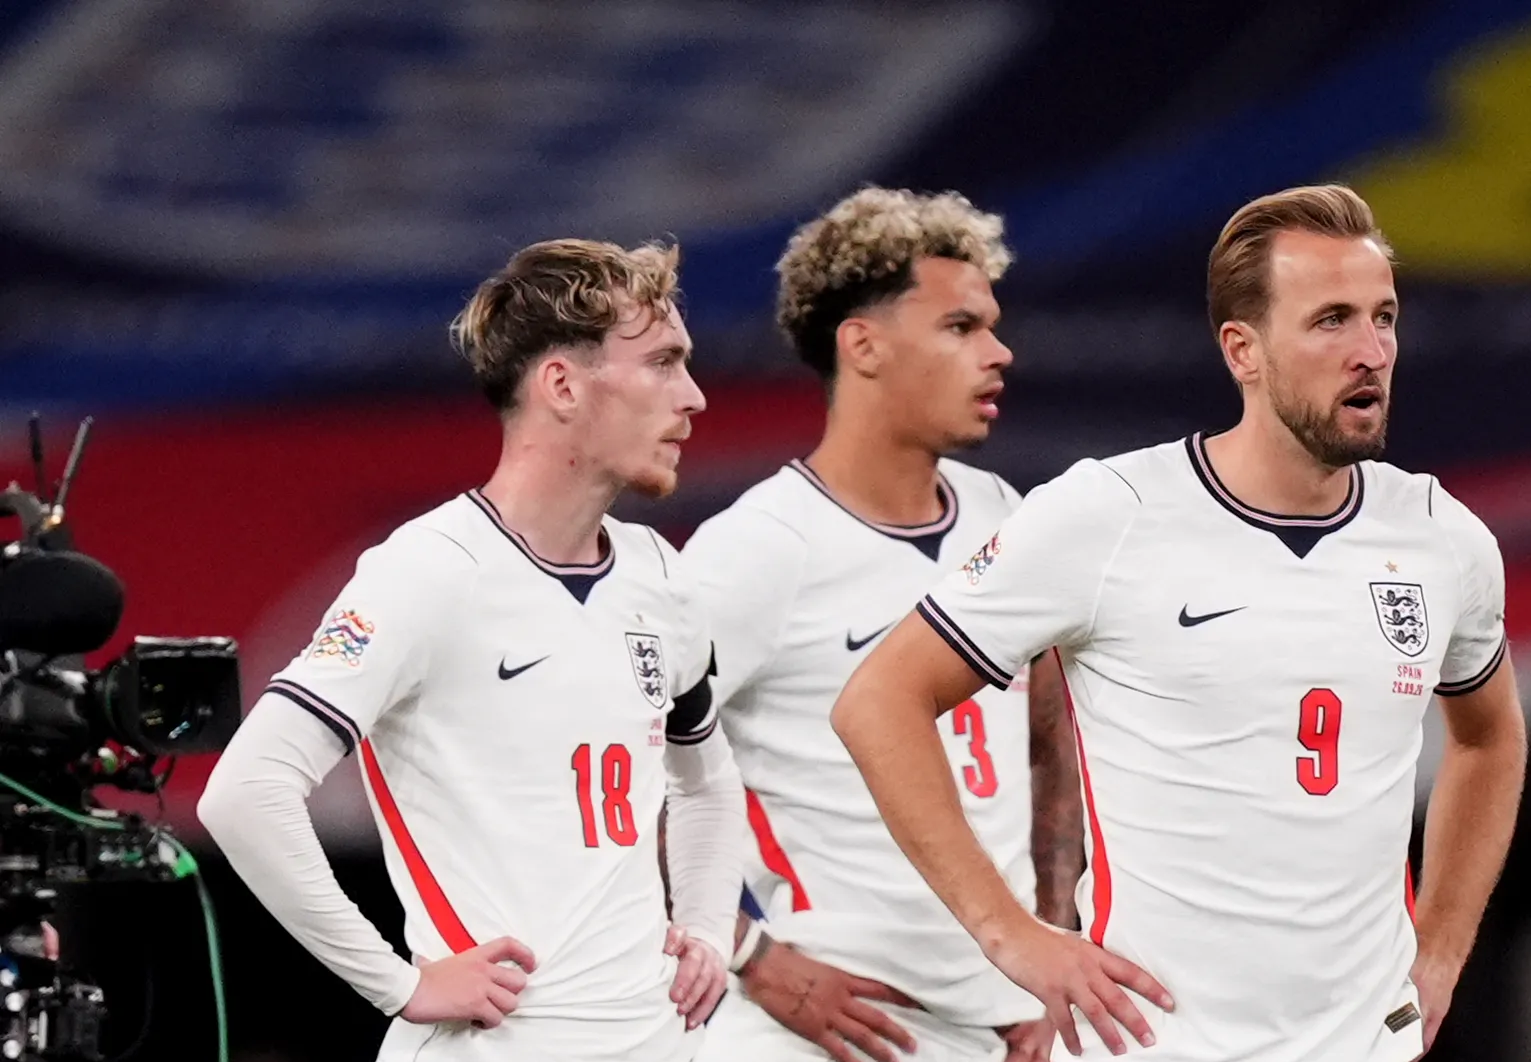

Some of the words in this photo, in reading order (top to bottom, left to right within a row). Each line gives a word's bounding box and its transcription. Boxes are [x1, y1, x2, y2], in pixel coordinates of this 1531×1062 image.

[1396, 664, 1423, 680] SPAIN
[952, 697, 999, 798] 3
[1296, 688, 1344, 797] 9
[572, 743, 639, 848] 18
